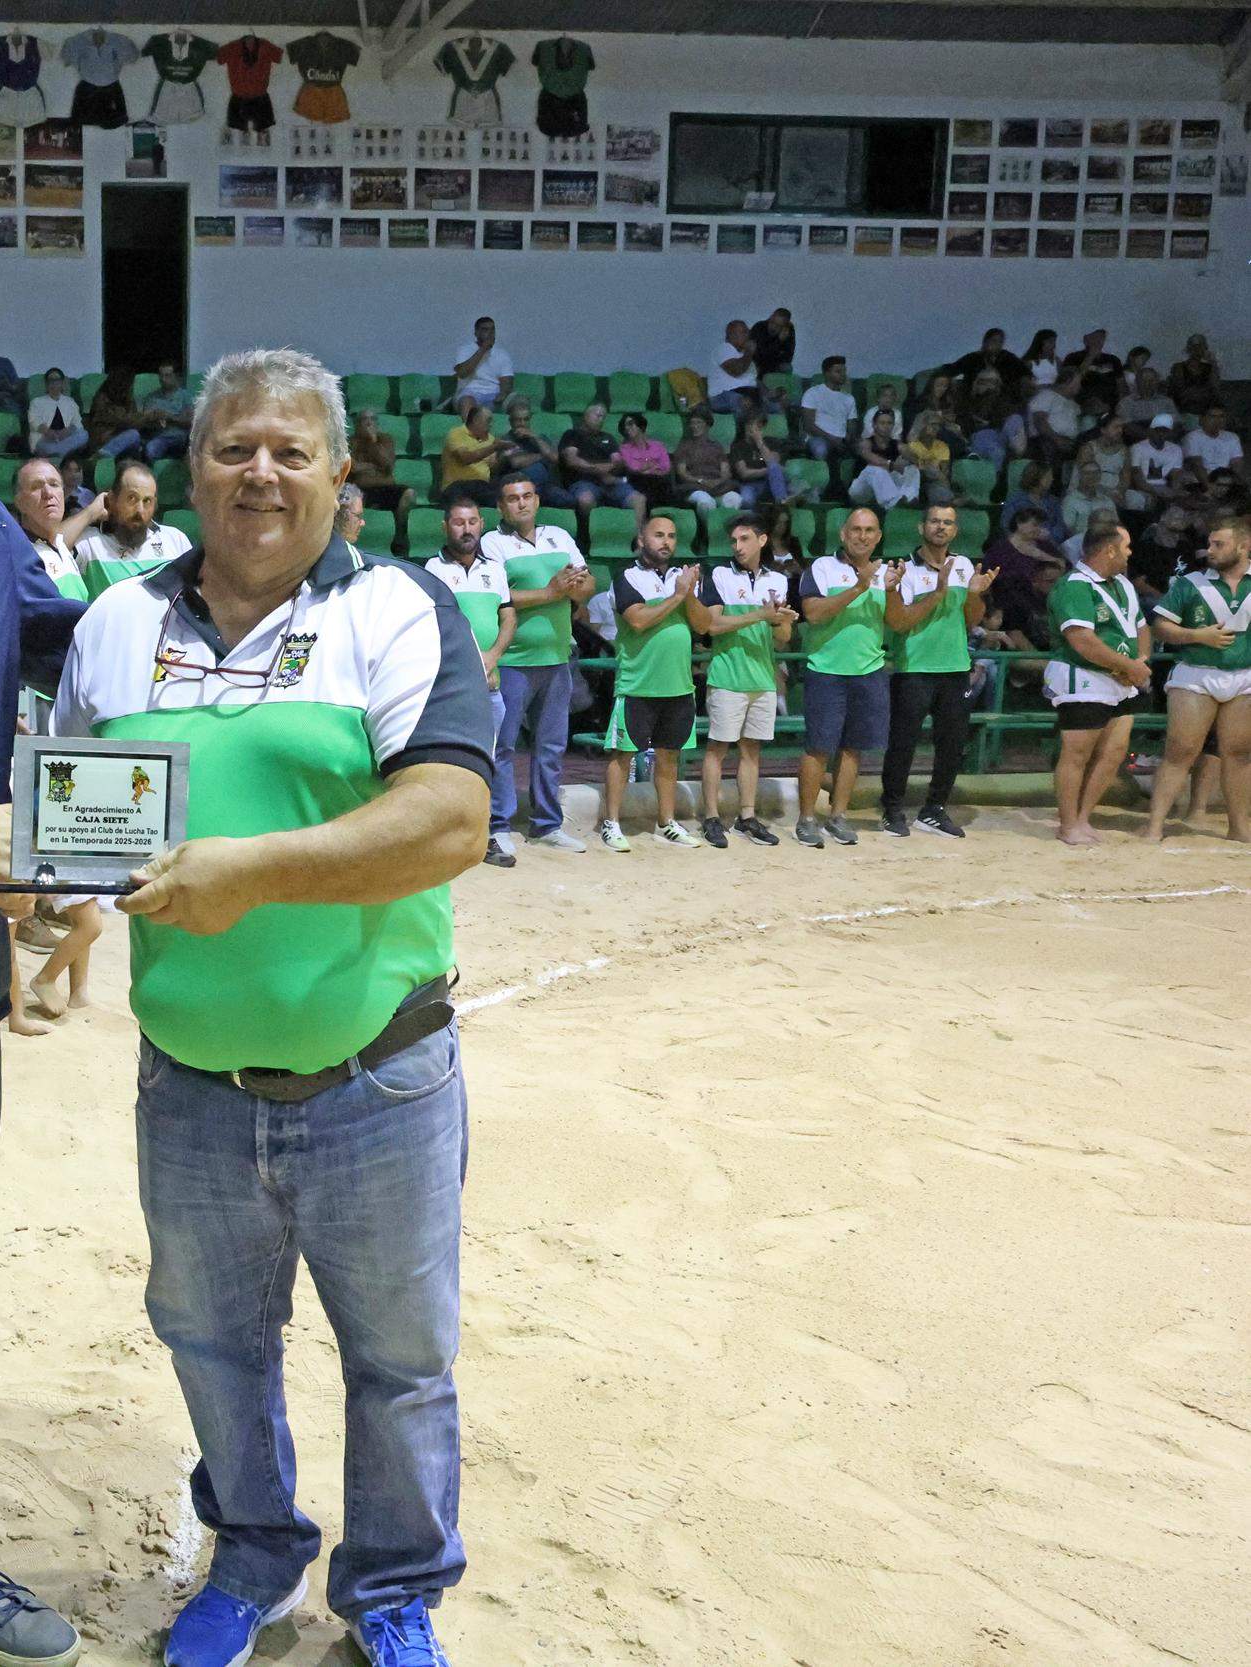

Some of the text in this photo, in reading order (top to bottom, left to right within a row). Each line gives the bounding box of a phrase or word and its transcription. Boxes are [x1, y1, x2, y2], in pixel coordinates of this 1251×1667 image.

[75, 805, 134, 814] Agradecimiento
[98, 826, 113, 834] Club
[70, 836, 113, 845] Temporada
[114, 837, 152, 845] 2025-2026
